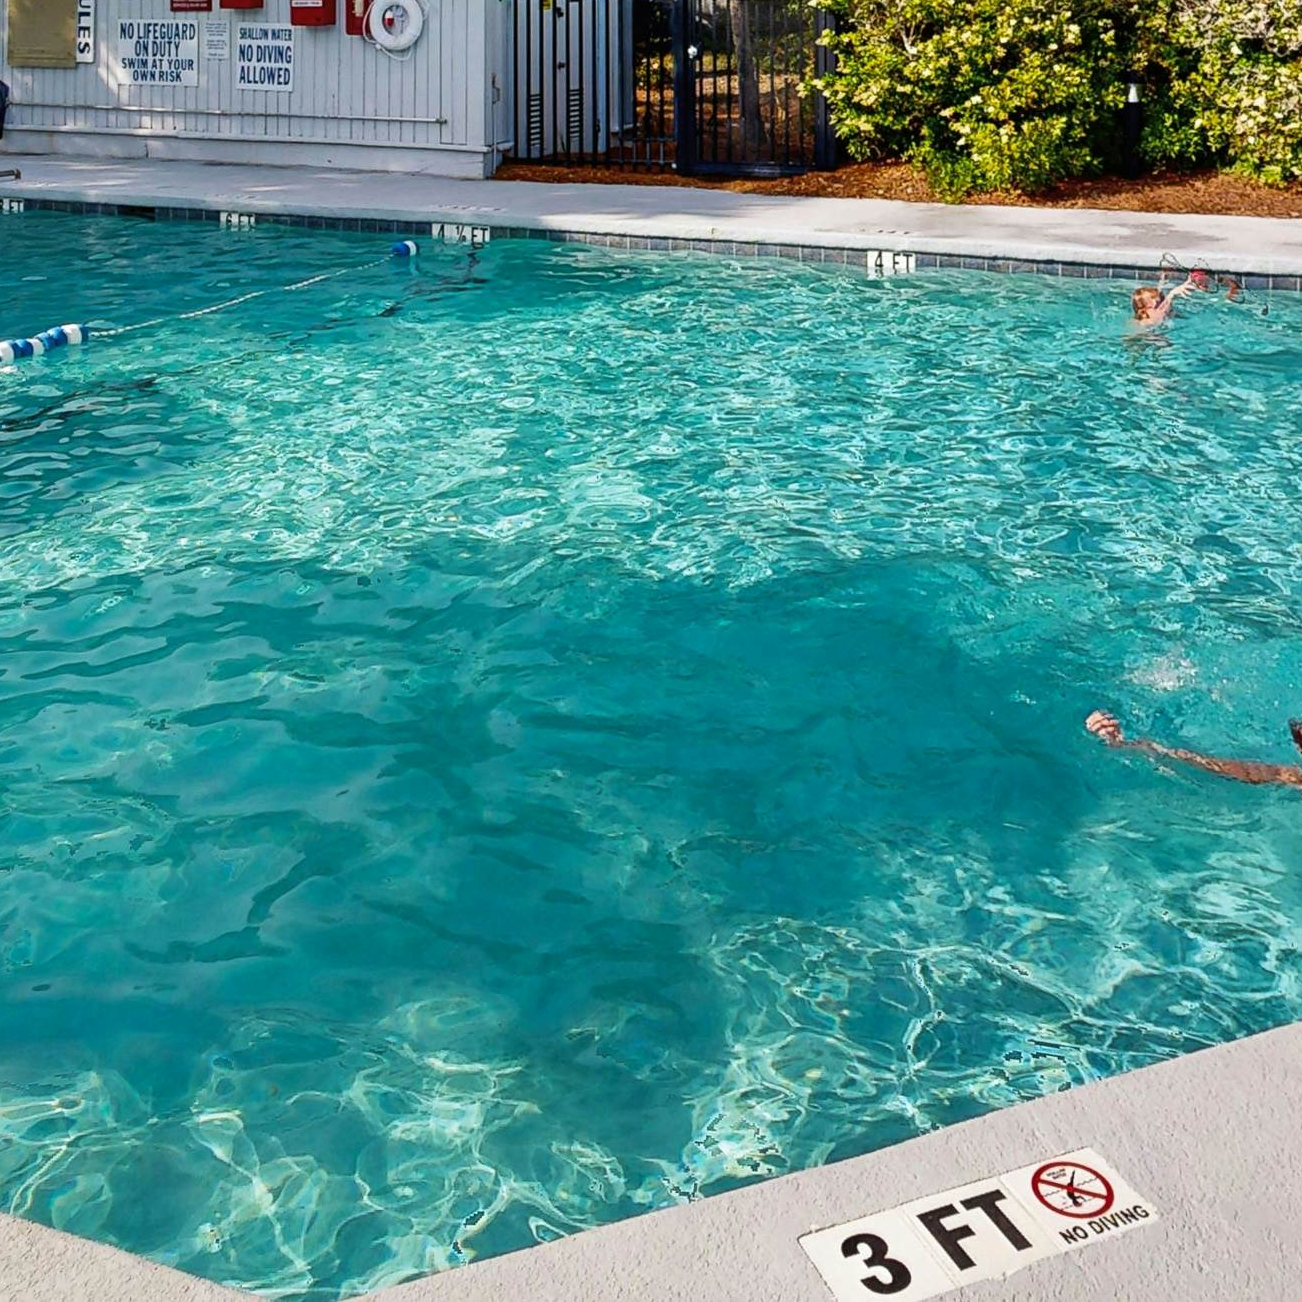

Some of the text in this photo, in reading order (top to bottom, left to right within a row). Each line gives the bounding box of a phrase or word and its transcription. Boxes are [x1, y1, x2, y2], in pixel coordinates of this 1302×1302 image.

[120, 22, 196, 40] NO LIFEGUARD
[239, 27, 292, 41] SHALLOW WATER
[135, 40, 180, 58] ON DUTY
[239, 44, 292, 64] NO DIVING
[121, 58, 195, 71] SWIM AT YOUR
[132, 70, 183, 83] OWN RISK
[239, 65, 291, 86] ALLOWED
[874, 250, 913, 276] 4 FT
[1058, 1204, 1151, 1245] NO DIVING
[840, 1189, 1034, 1295] 3 FT
